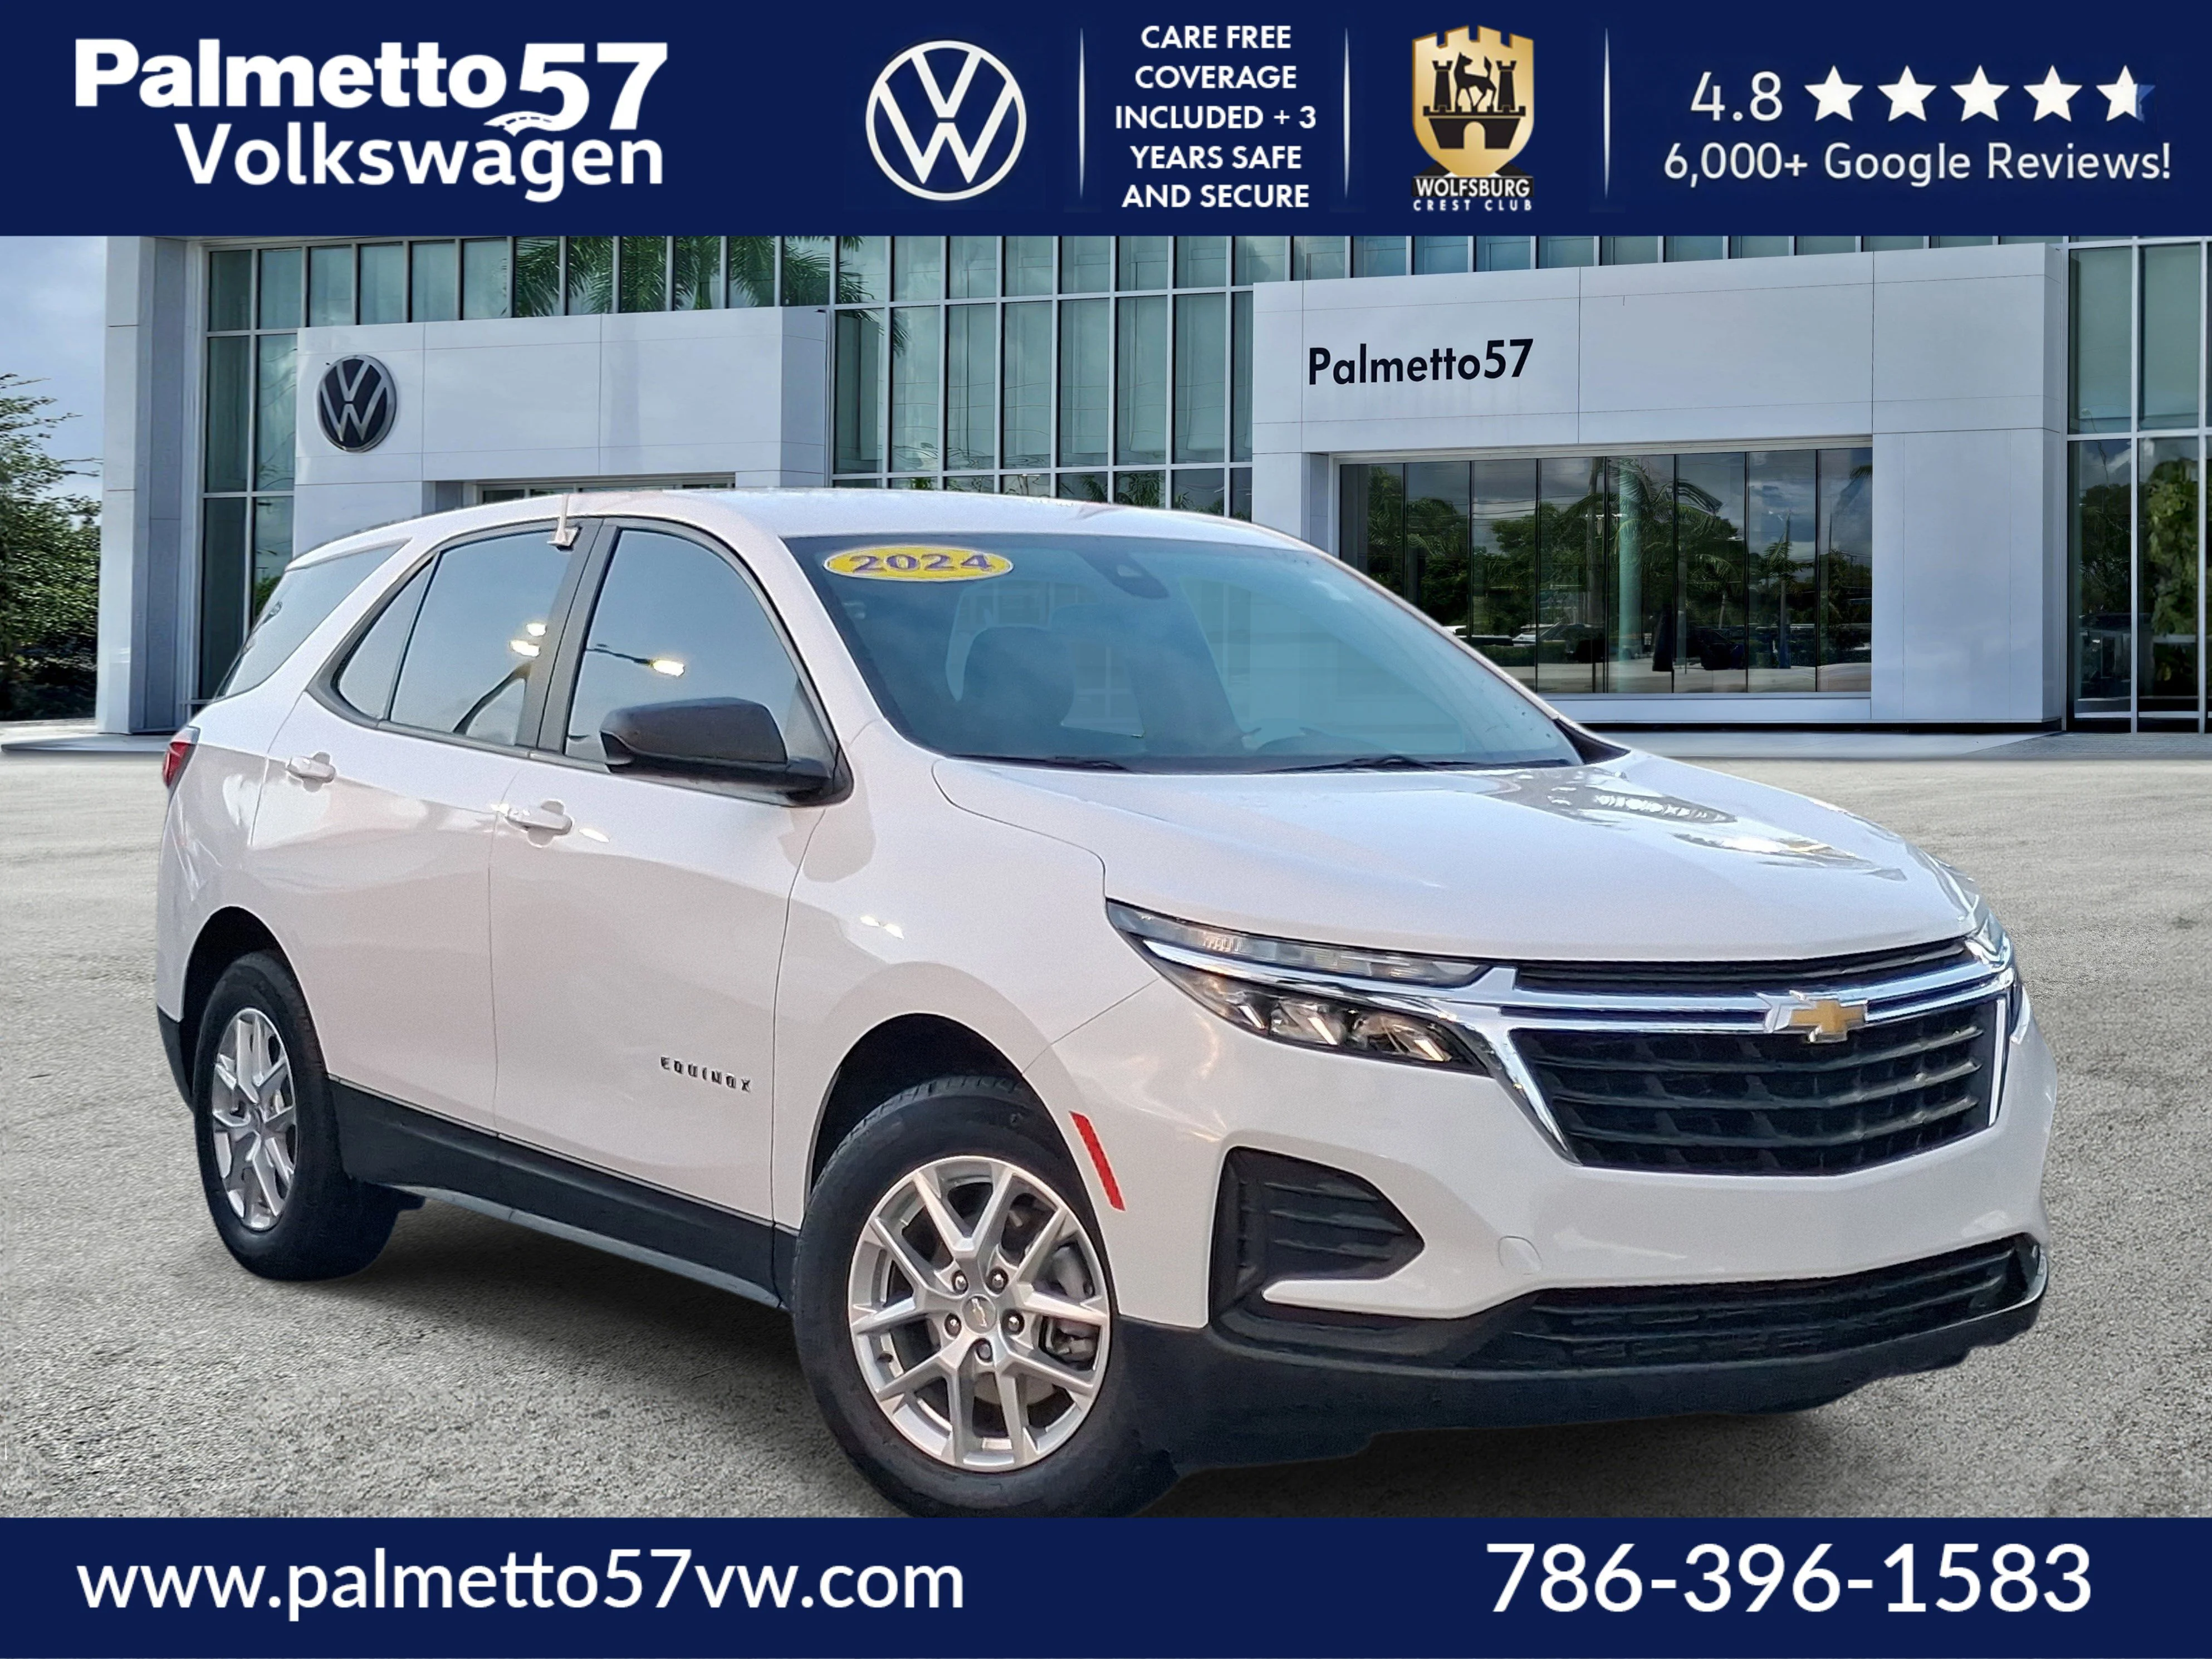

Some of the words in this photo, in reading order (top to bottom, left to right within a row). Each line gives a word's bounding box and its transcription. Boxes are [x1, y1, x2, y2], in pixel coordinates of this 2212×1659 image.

[1309, 338, 1534, 385] Palmetto57
[849, 552, 996, 573] 2024
[660, 1056, 751, 1093] EQUINOX
